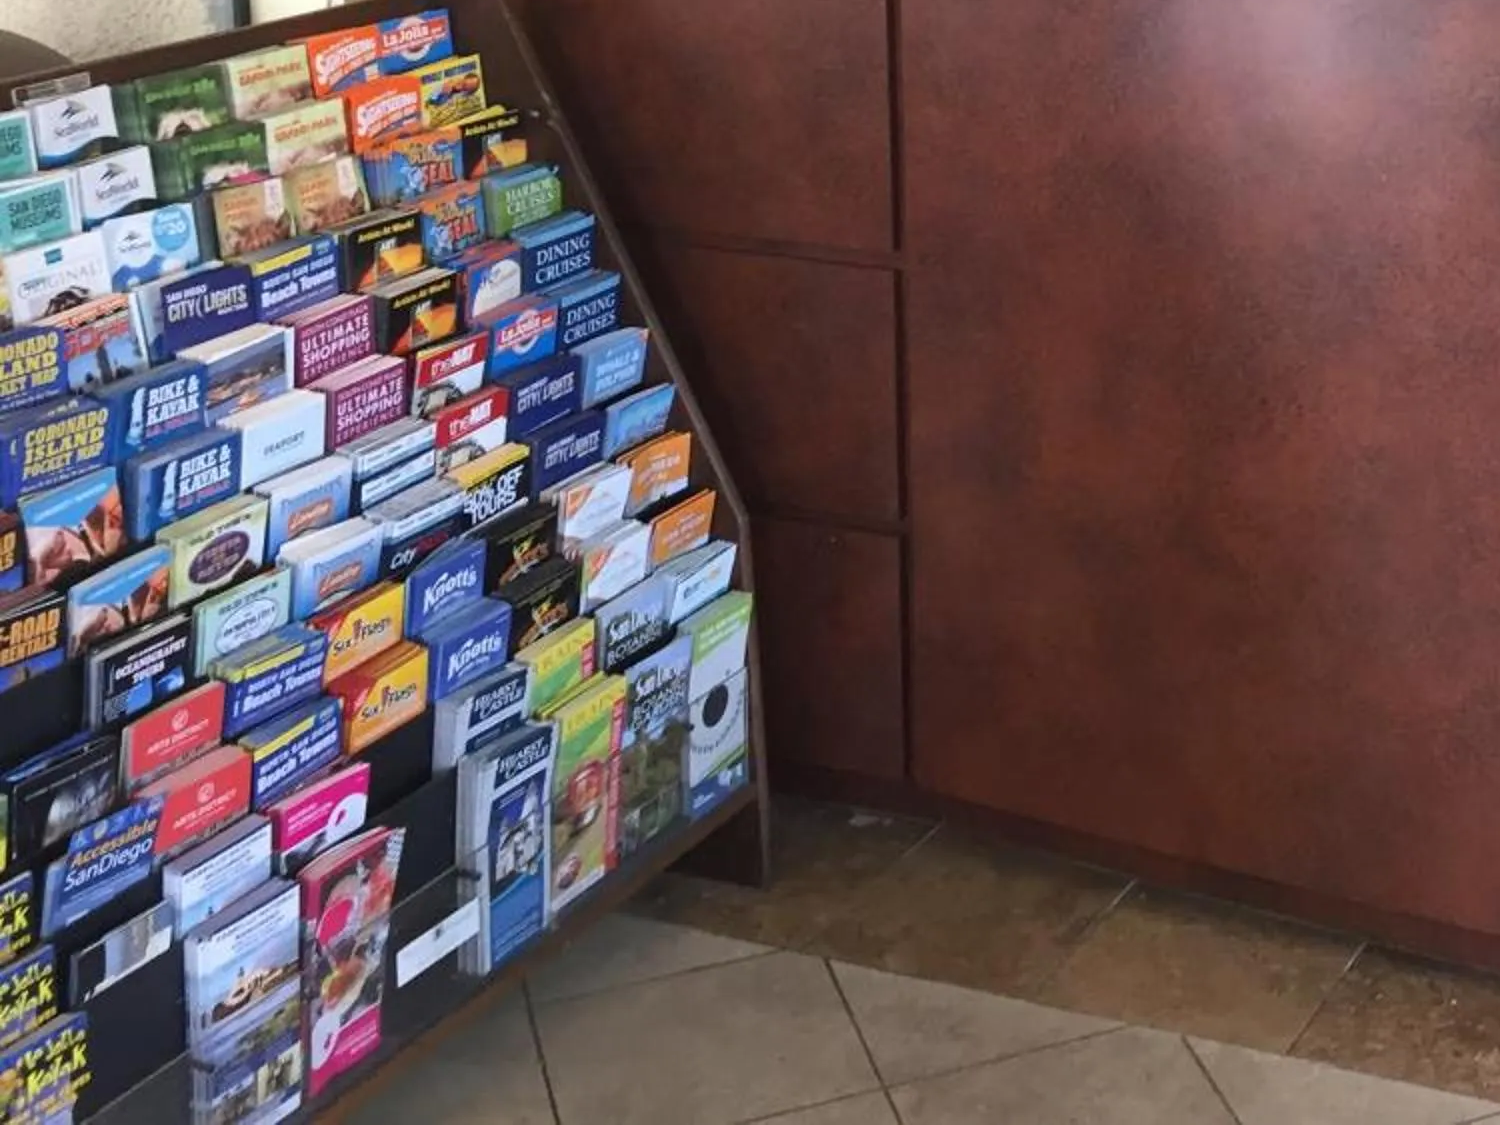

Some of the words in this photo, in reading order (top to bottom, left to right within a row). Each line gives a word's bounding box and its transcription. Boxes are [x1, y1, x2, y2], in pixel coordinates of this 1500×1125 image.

[537, 232, 592, 266] DINING
[535, 250, 592, 284] CRUISES
[168, 299, 196, 323] CITY
[204, 283, 248, 315] LIGHTS
[261, 282, 299, 308] Beach
[566, 292, 617, 325] DINING
[301, 312, 370, 354] ULTIMATE
[563, 311, 617, 344] CRUISES
[303, 327, 371, 368] SHOPPING
[303, 341, 371, 380] EXPERIENCE
[0, 351, 58, 380] LAND
[149, 379, 186, 404] BIKE
[187, 374, 200, 394] &
[336, 376, 404, 417] ULTIMATE
[148, 393, 200, 426] KAYAK
[336, 391, 404, 431] SHOPPING
[25, 407, 110, 448] CORONADO
[25, 426, 105, 462] ISLAND
[23, 451, 72, 480] POCKET
[180, 450, 217, 477] BIKE
[219, 443, 232, 463] &
[178, 464, 232, 496] KAYAK
[496, 464, 525, 495] OFF
[471, 490, 517, 525] TOURS
[422, 564, 478, 615] Knott's
[447, 629, 503, 681] Knott's
[473, 677, 518, 710] HEARST
[479, 687, 524, 721] CASTLE
[497, 735, 544, 771] HEARST
[504, 744, 549, 780] CASTLE
[71, 817, 158, 869] Accessible
